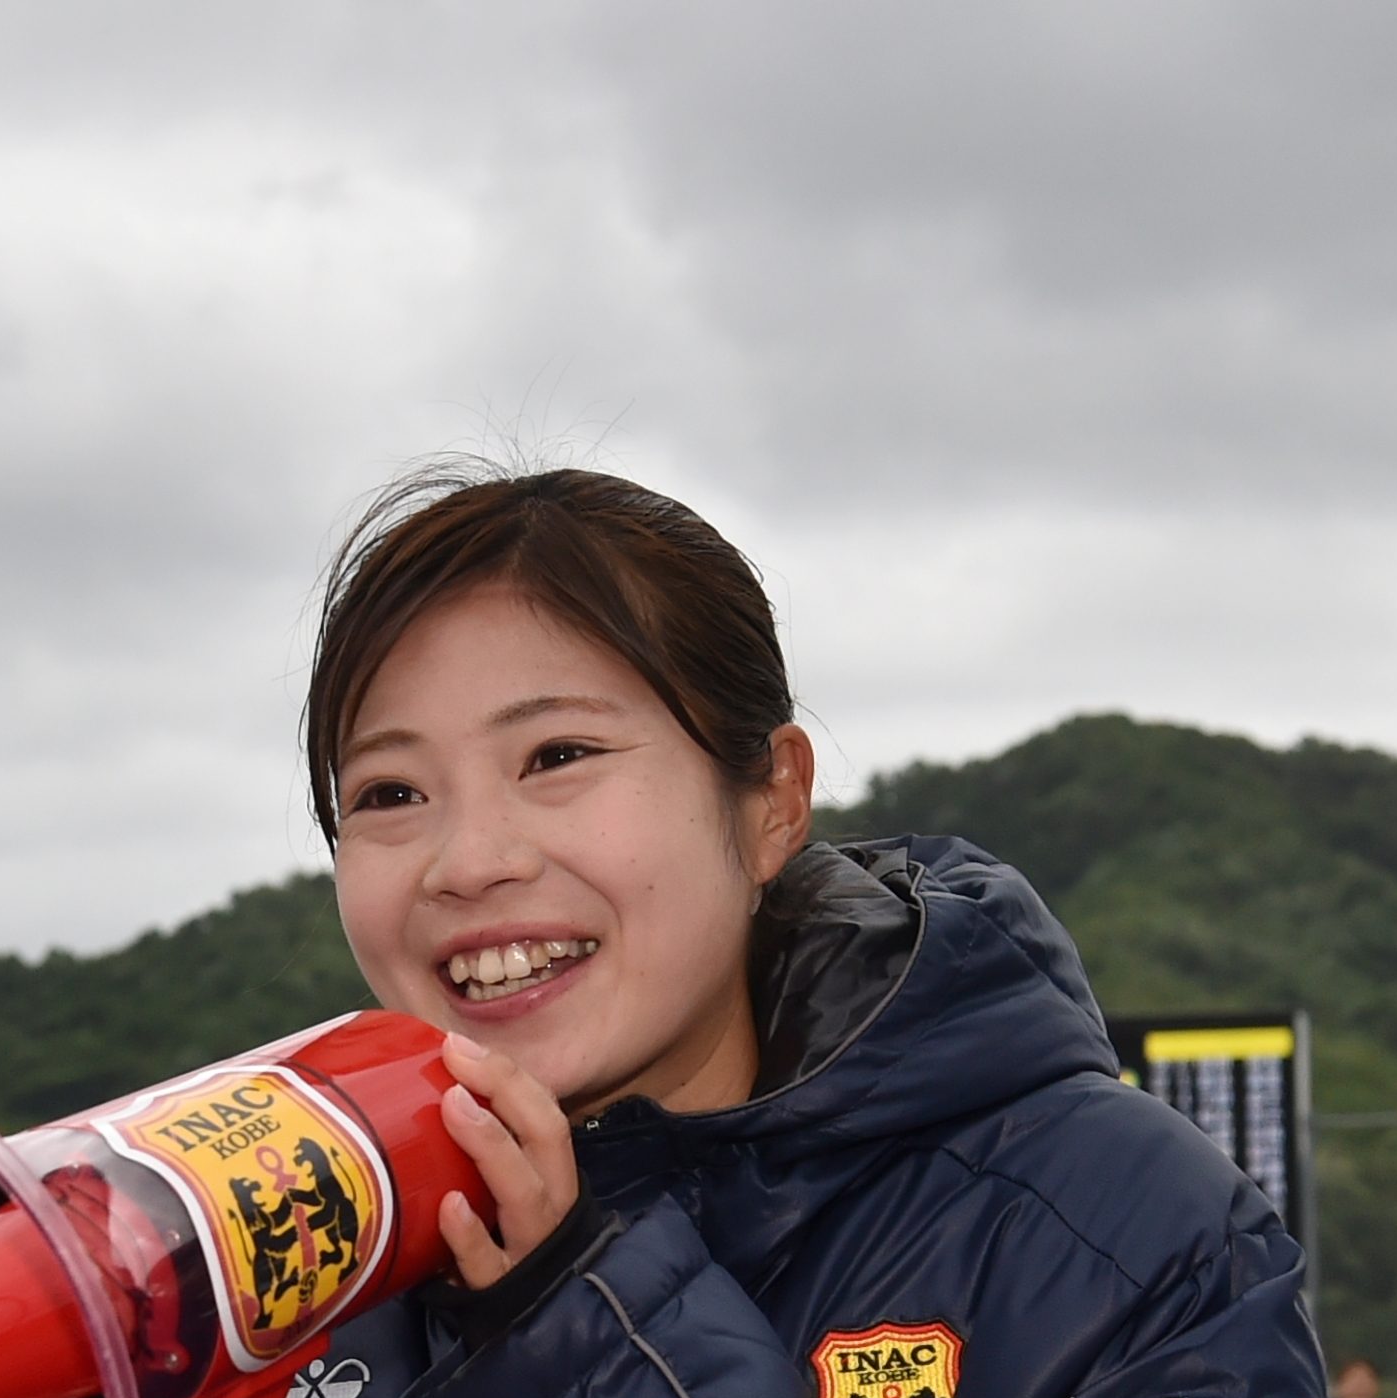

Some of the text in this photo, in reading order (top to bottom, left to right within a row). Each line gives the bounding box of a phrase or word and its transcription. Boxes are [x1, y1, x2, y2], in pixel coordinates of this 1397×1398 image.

[158, 1086, 275, 1152] INAC
[209, 1114, 281, 1160] KOBE
[837, 1344, 938, 1374] INAC
[858, 1367, 921, 1386] KOBE
